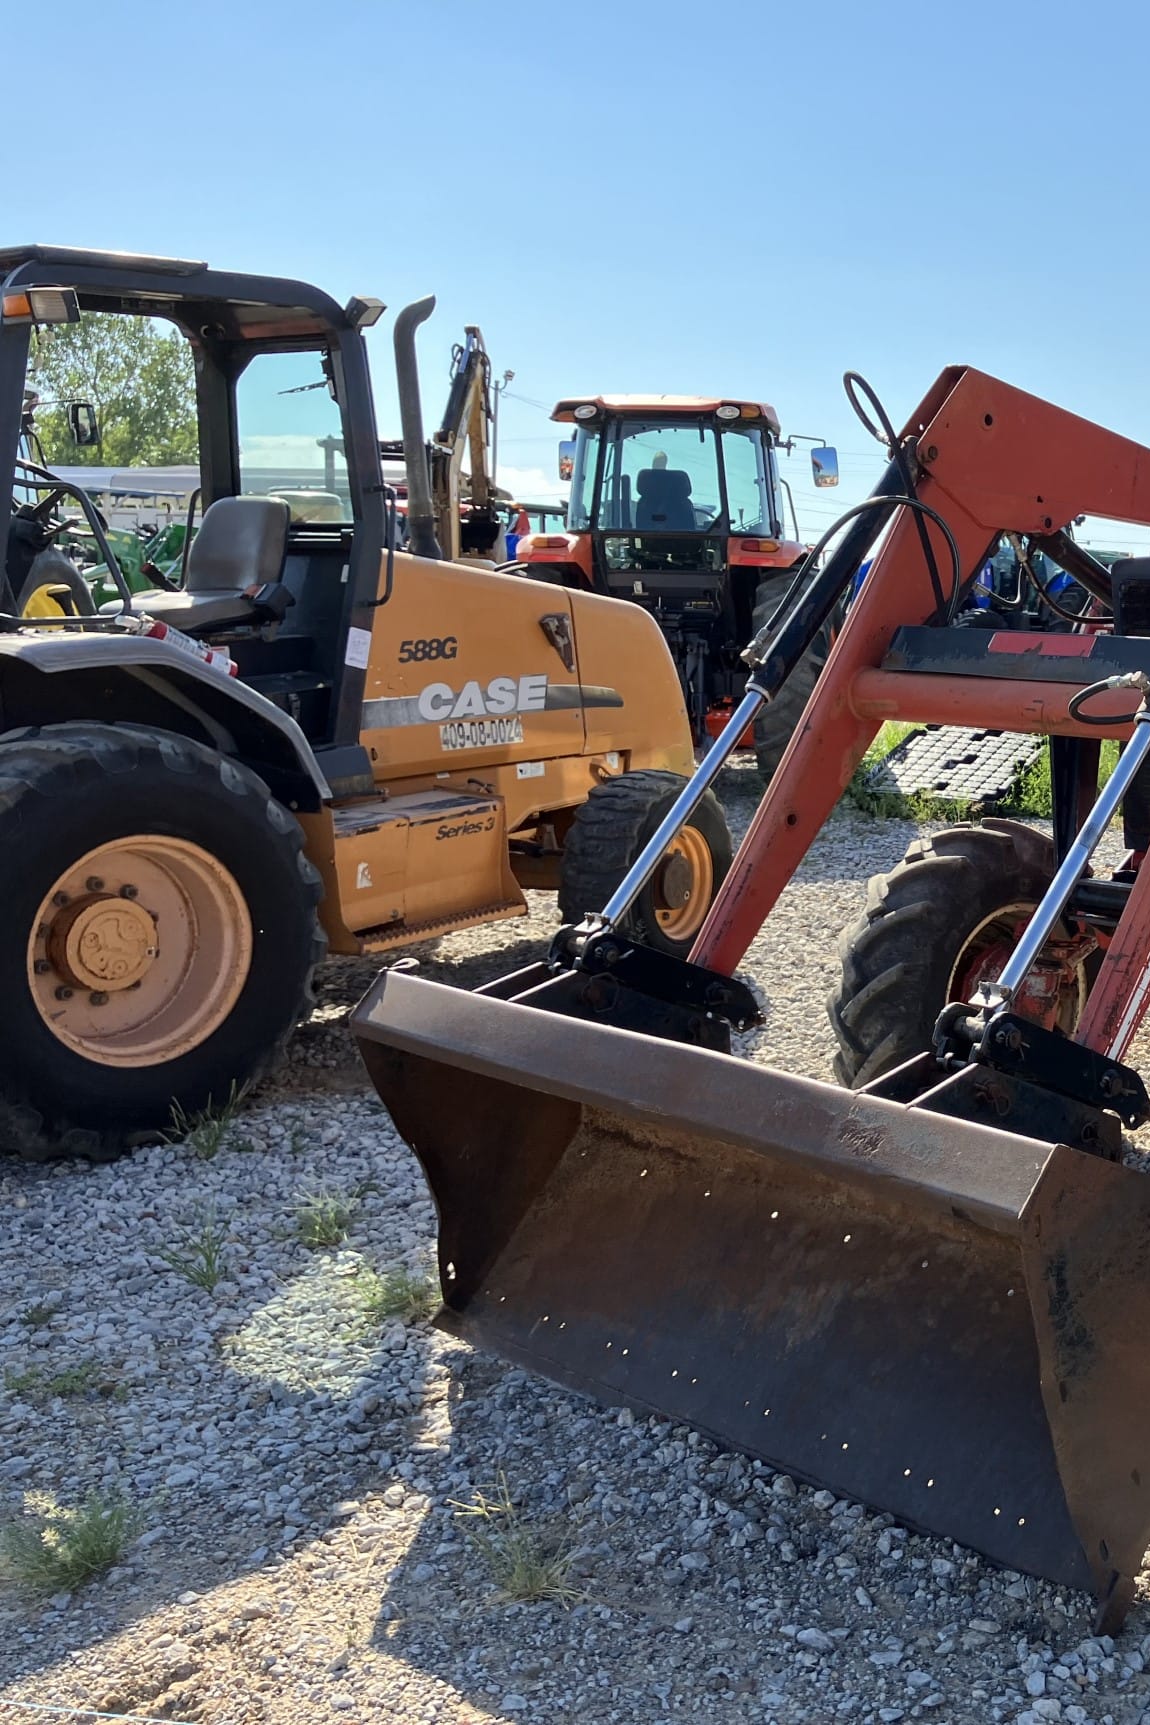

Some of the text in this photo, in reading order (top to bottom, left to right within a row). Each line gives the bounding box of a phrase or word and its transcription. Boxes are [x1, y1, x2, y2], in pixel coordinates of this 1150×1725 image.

[398, 636, 458, 663] 588G
[418, 675, 548, 721] CASE
[435, 816, 496, 841] Series 3
